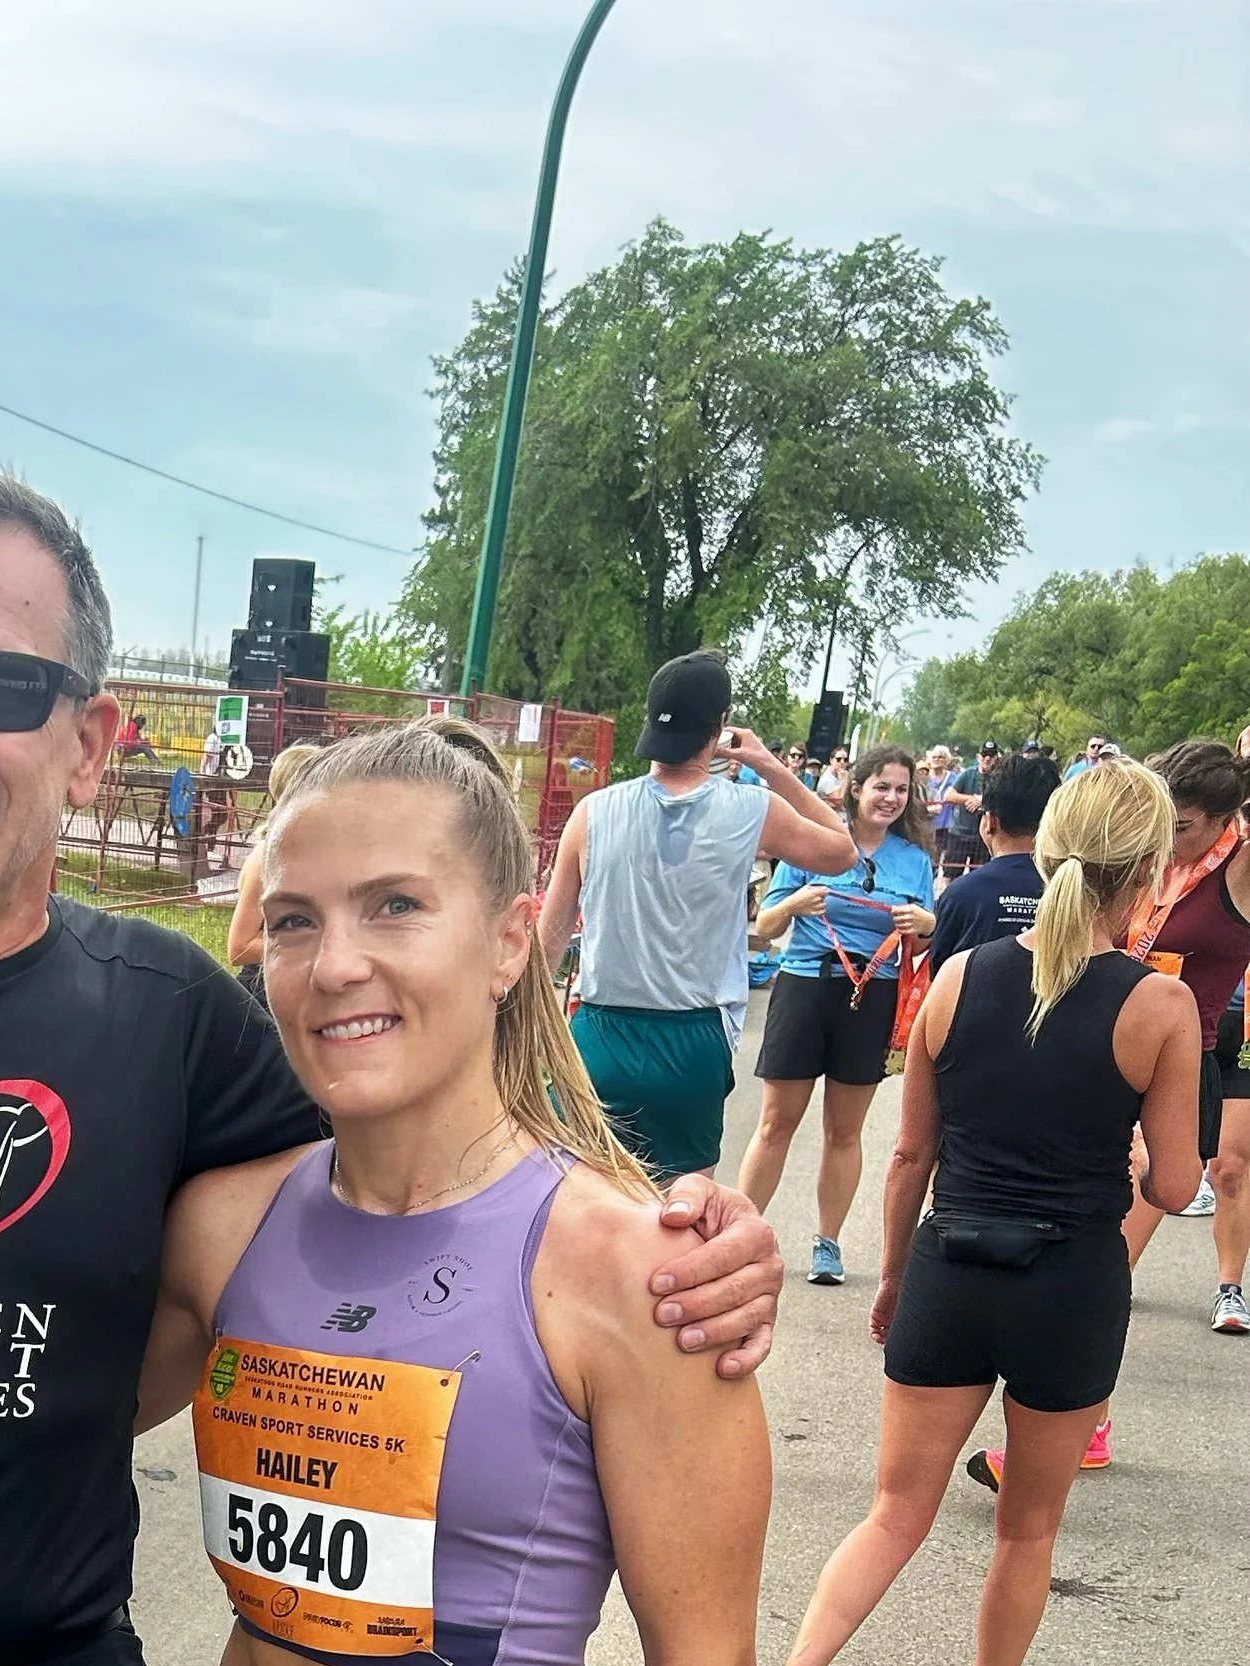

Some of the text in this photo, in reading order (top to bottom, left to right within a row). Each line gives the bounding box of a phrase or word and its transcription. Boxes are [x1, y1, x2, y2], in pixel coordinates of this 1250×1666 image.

[998, 896, 1039, 906] SASKATCH
[423, 1266, 458, 1305] S
[240, 1353, 386, 1392] SASKATCHEWAN
[276, 1381, 293, 1390] ROAD
[326, 1388, 373, 1401] ASSOCIATION
[251, 1386, 359, 1416] MARATHON
[212, 1406, 405, 1454] CRAVEN SPORT SERVICES 5K
[255, 1446, 339, 1491] HAILEY
[227, 1492, 369, 1592] 5840
